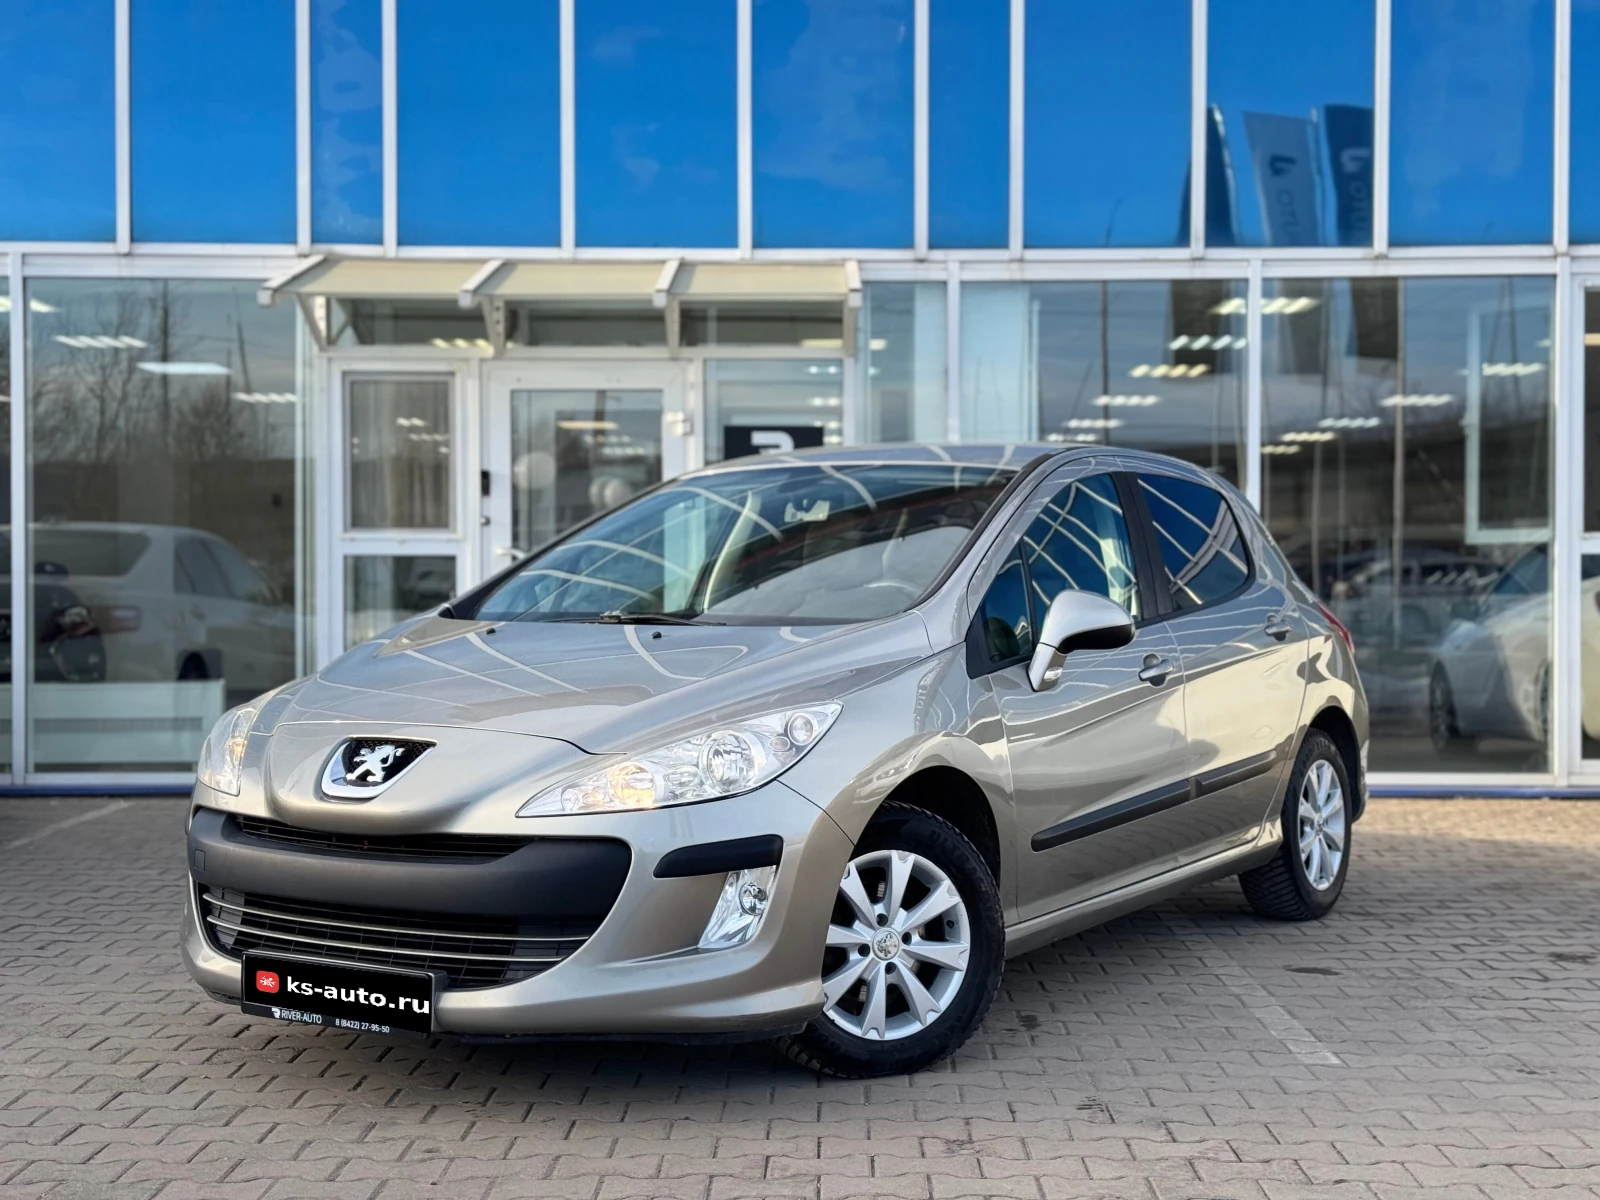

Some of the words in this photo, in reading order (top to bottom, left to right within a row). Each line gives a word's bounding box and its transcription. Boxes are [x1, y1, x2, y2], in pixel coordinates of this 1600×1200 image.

[281, 1009, 322, 1024] RIVER-AUTO
[335, 1018, 340, 1026] 8
[341, 1019, 360, 1030] (8422)
[361, 1022, 390, 1034] 27-95-50
